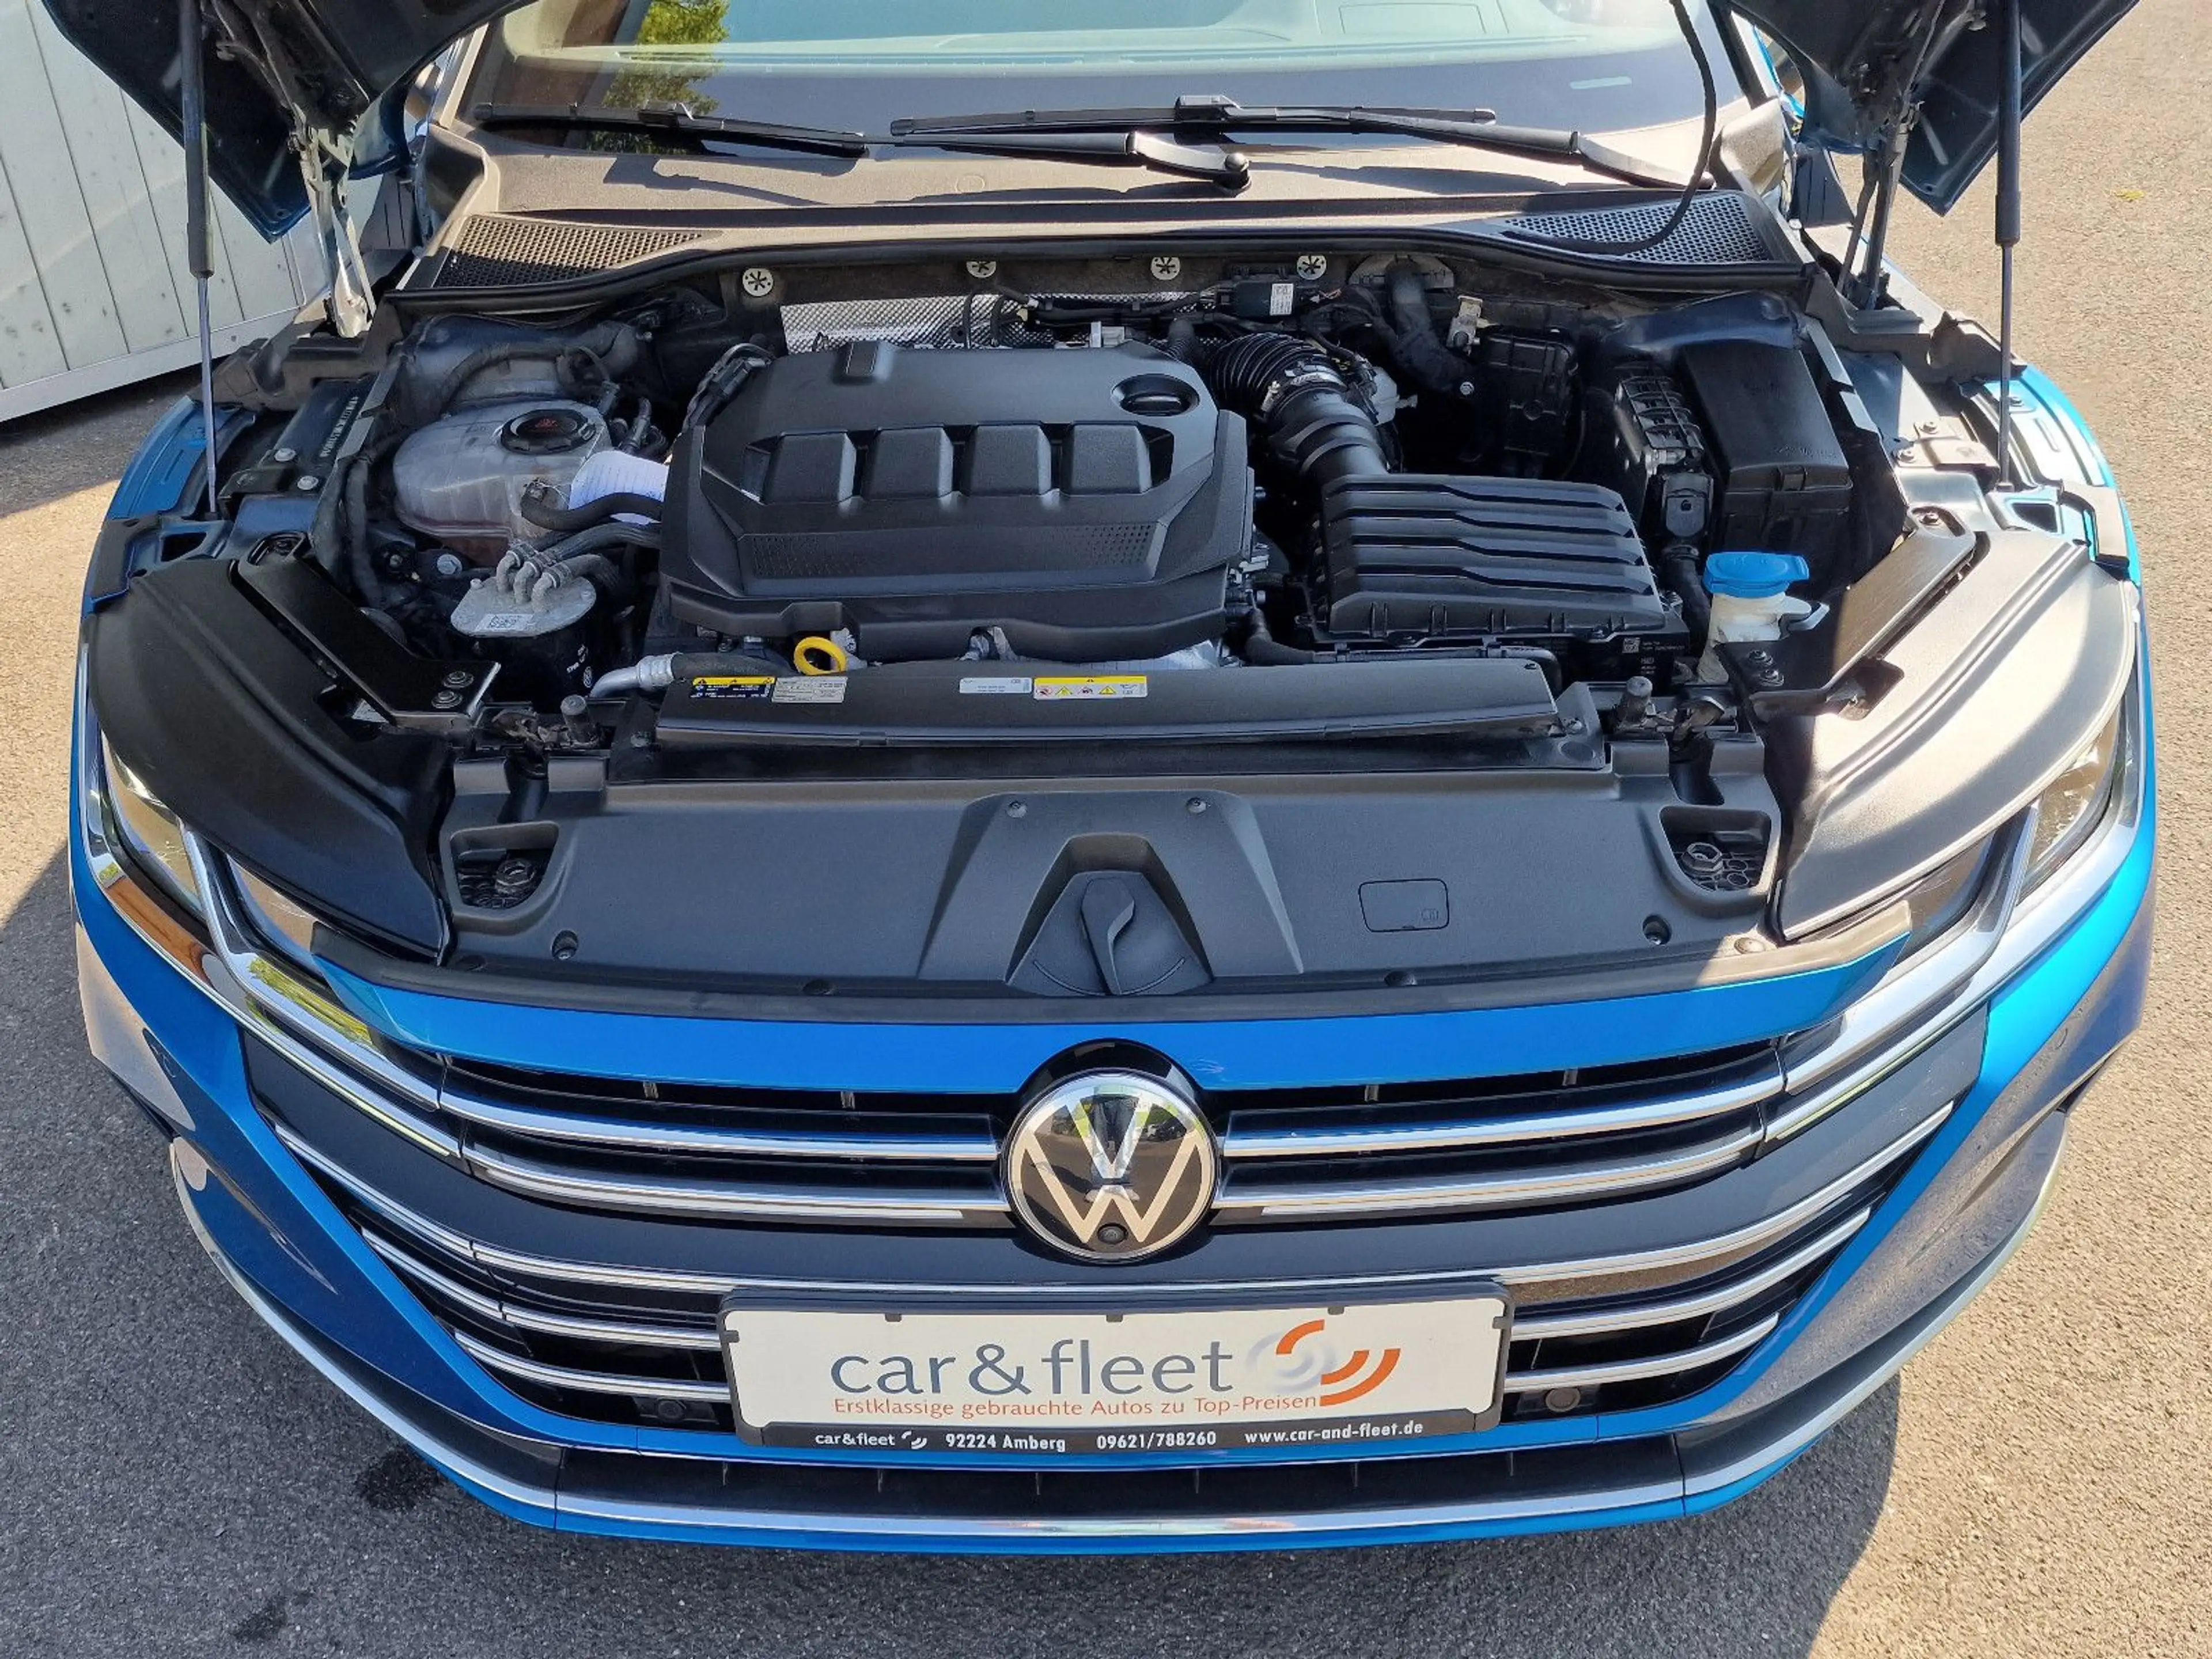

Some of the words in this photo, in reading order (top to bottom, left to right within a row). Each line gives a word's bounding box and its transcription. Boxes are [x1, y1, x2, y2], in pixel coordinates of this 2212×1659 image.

[835, 1398, 954, 1419] Erstklassige
[961, 1400, 1082, 1419] gebrauchte
[1090, 1400, 1152, 1415] Autos
[1161, 1403, 1184, 1414] zu
[1194, 1395, 1316, 1415] Top-Preisen
[815, 1433, 895, 1446] car&fleet
[945, 1433, 997, 1448] 92224
[1002, 1435, 1066, 1453] Amberg
[1097, 1431, 1216, 1449] 09621/788260
[1244, 1420, 1423, 1443] www.car-and-fleet.de
